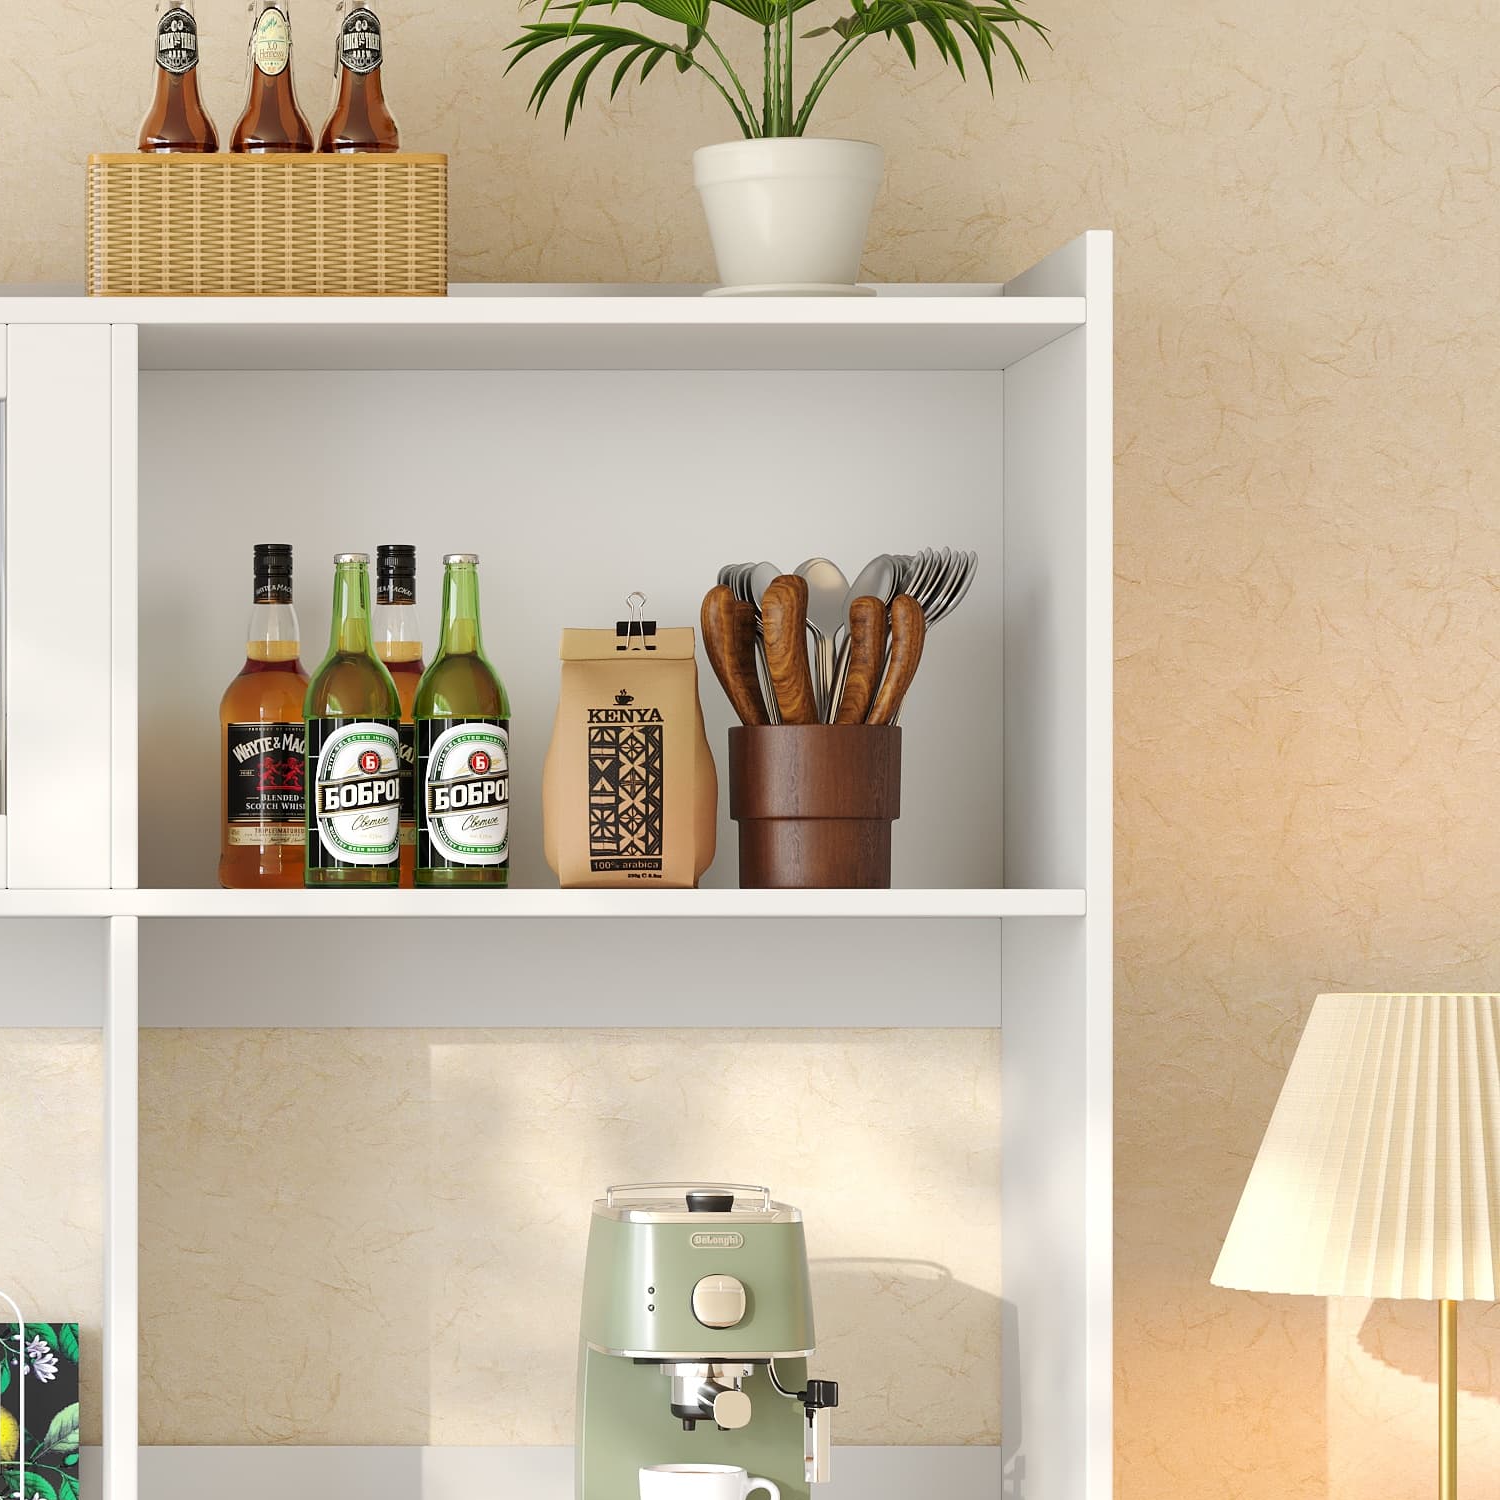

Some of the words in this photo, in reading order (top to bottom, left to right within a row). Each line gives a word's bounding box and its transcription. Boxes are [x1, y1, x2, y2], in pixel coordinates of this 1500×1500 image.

[587, 708, 664, 723] KENYA
[232, 736, 275, 763] WHYTE
[273, 737, 281, 749] &
[366, 756, 376, 769] Б
[476, 756, 486, 769] Б
[622, 861, 659, 869] arabica
